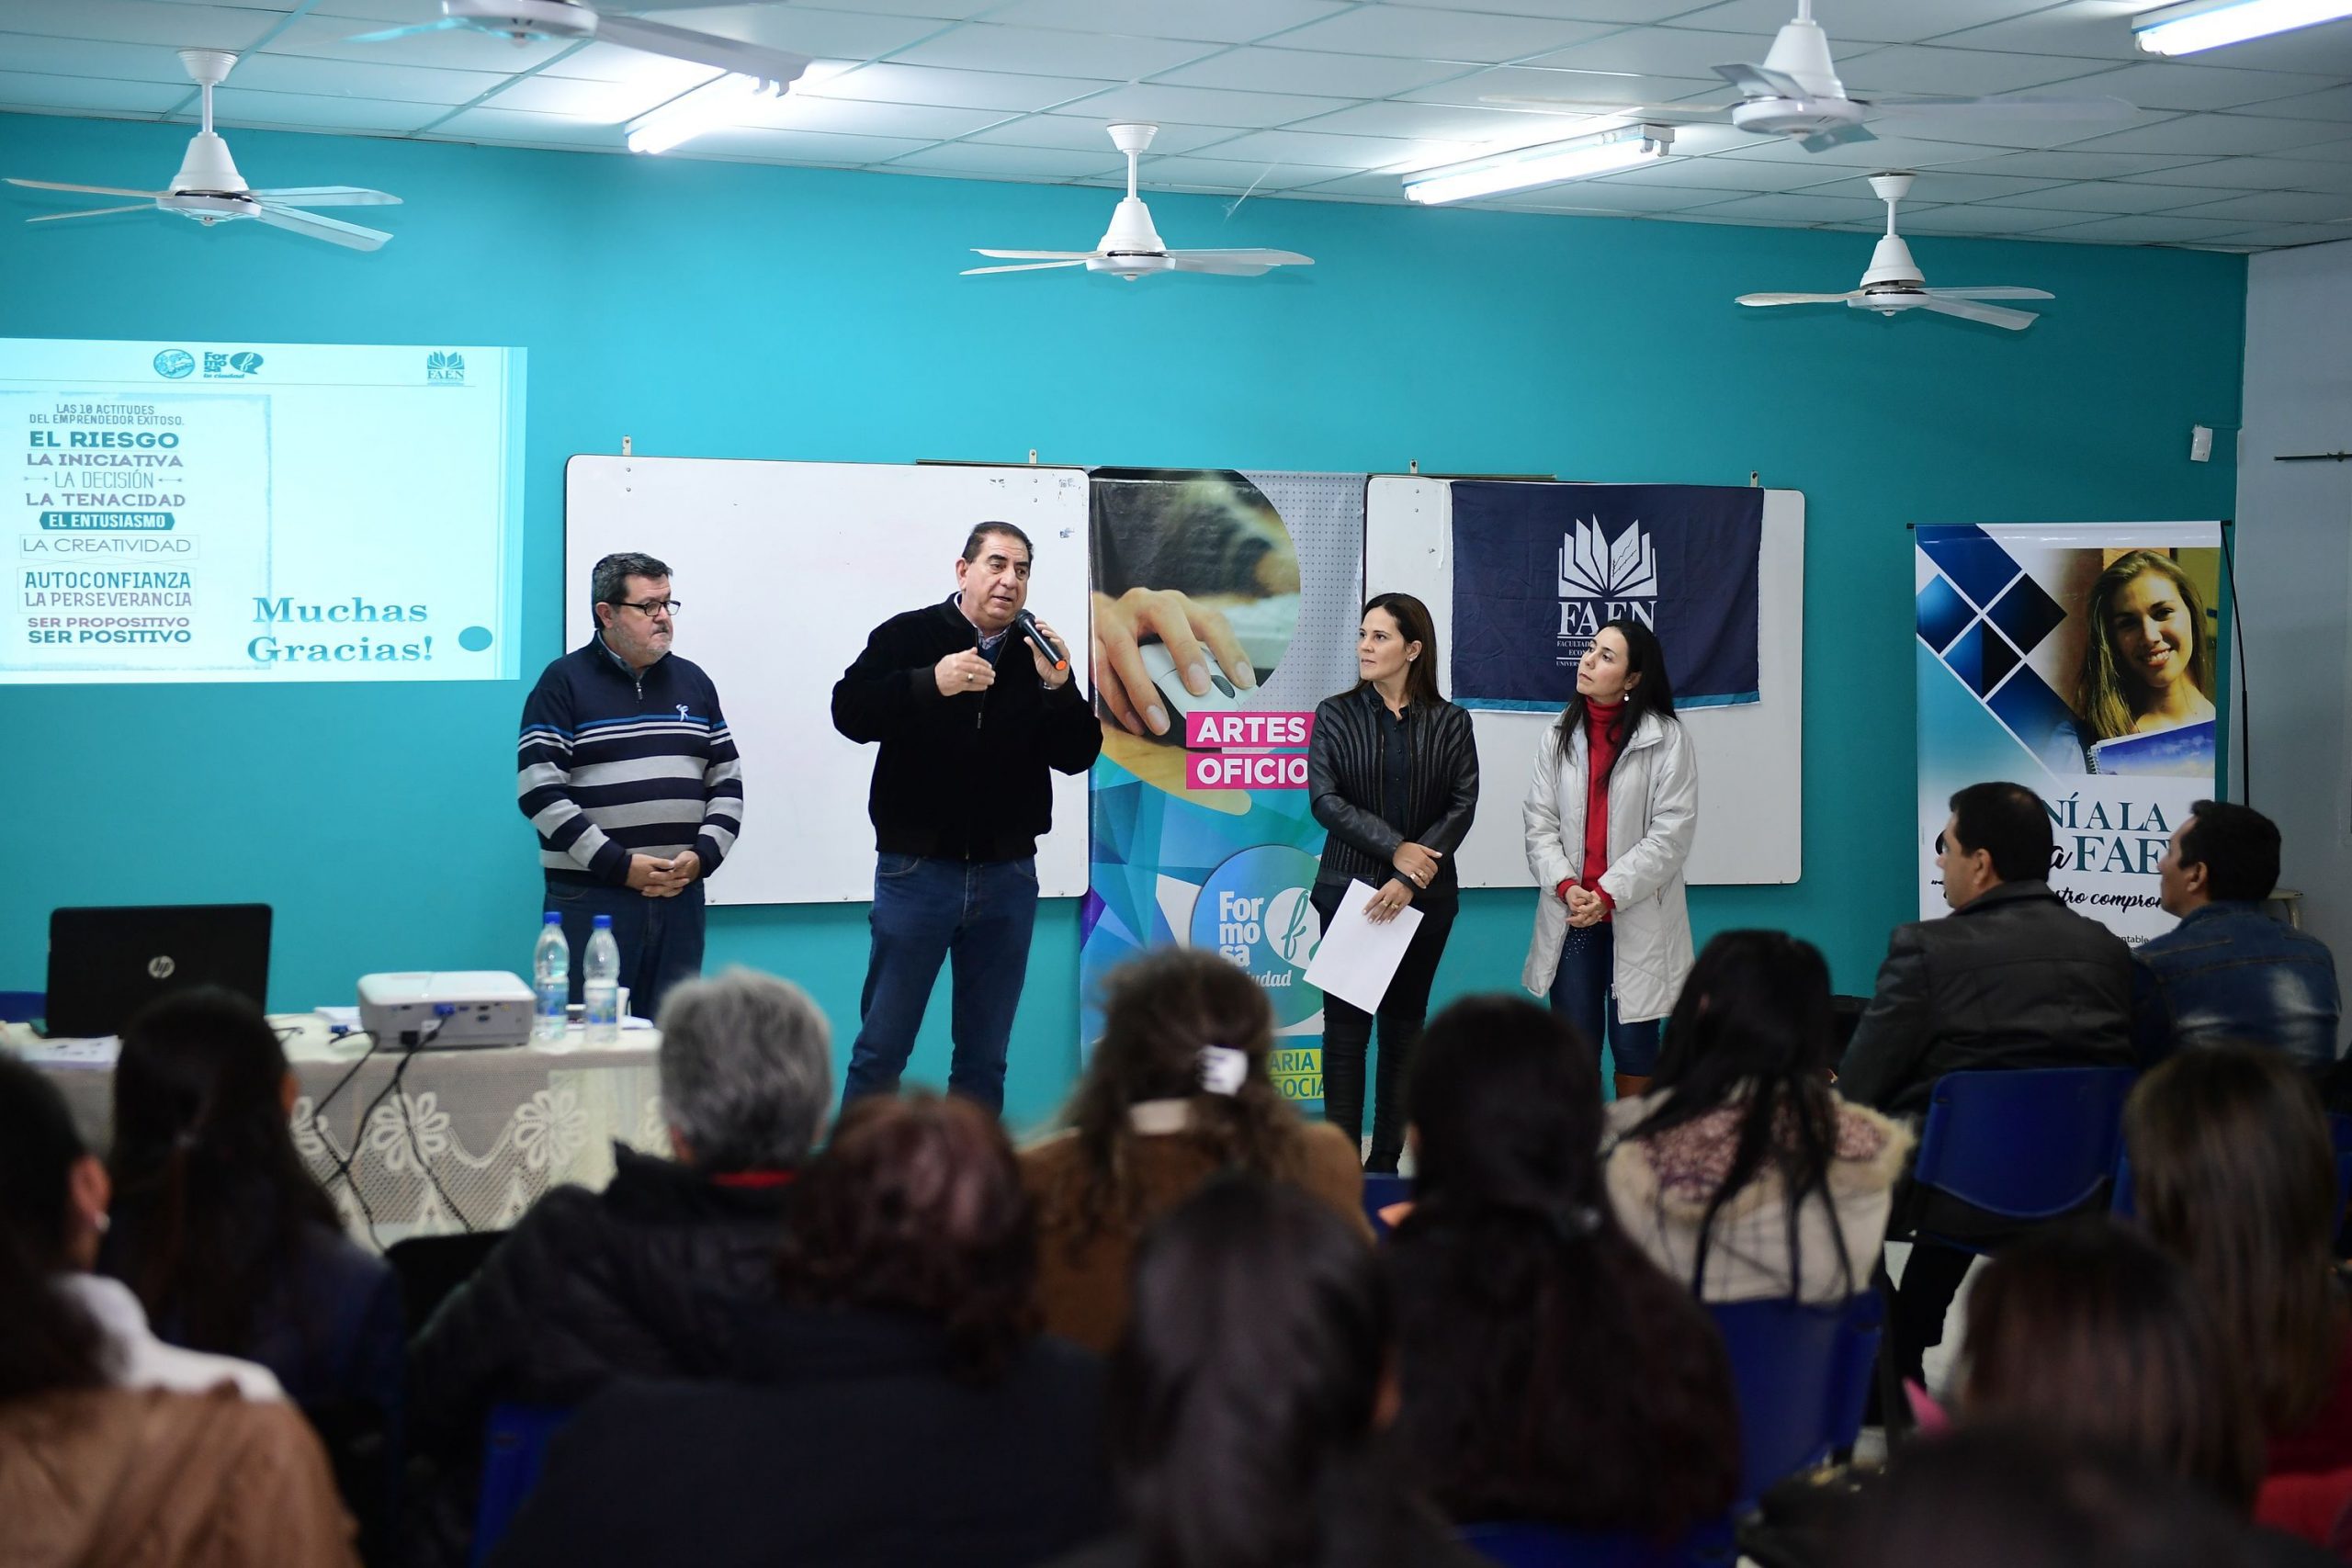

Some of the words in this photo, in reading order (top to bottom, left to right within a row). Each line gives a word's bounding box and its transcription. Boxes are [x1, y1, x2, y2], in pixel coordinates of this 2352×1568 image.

[204, 352, 229, 360] For
[427, 370, 464, 379] FAEN
[56, 404, 77, 414] LAS
[80, 404, 92, 414] 10
[96, 405, 154, 415] ACTITUDES
[29, 414, 50, 423] DEL
[52, 414, 134, 424] EMPRENDEDOR
[29, 431, 61, 447] EL
[70, 432, 179, 448] RIESGO
[27, 454, 53, 466] LA
[59, 454, 183, 467] INICIATIVA
[55, 471, 74, 488] LA
[83, 469, 153, 489] DECISIÓN
[26, 493, 53, 506] LA
[62, 493, 186, 507] TENACIDAD
[49, 514, 66, 527] EL
[71, 514, 165, 528] ENTUSIASMO
[23, 538, 48, 551] LA
[54, 538, 191, 552] CREATIVIDAD
[25, 571, 191, 589] AUTOCONFIANZA
[25, 592, 46, 606] LA
[51, 592, 192, 606] PERSEVERANCIA
[252, 597, 427, 623] Muchas
[28, 617, 62, 627] SER
[66, 617, 190, 627] PROPOSITIVO
[28, 630, 73, 643] SER
[79, 630, 192, 643] POSITIVO
[247, 636, 433, 662] Gracias!
[1196, 716, 1306, 743] ARTES
[1196, 758, 1309, 784] OFICIO
[2072, 835, 2171, 875] FAE
[1219, 891, 1264, 921] For
[1219, 922, 1261, 944] mo
[1270, 1052, 1315, 1072] ARIA
